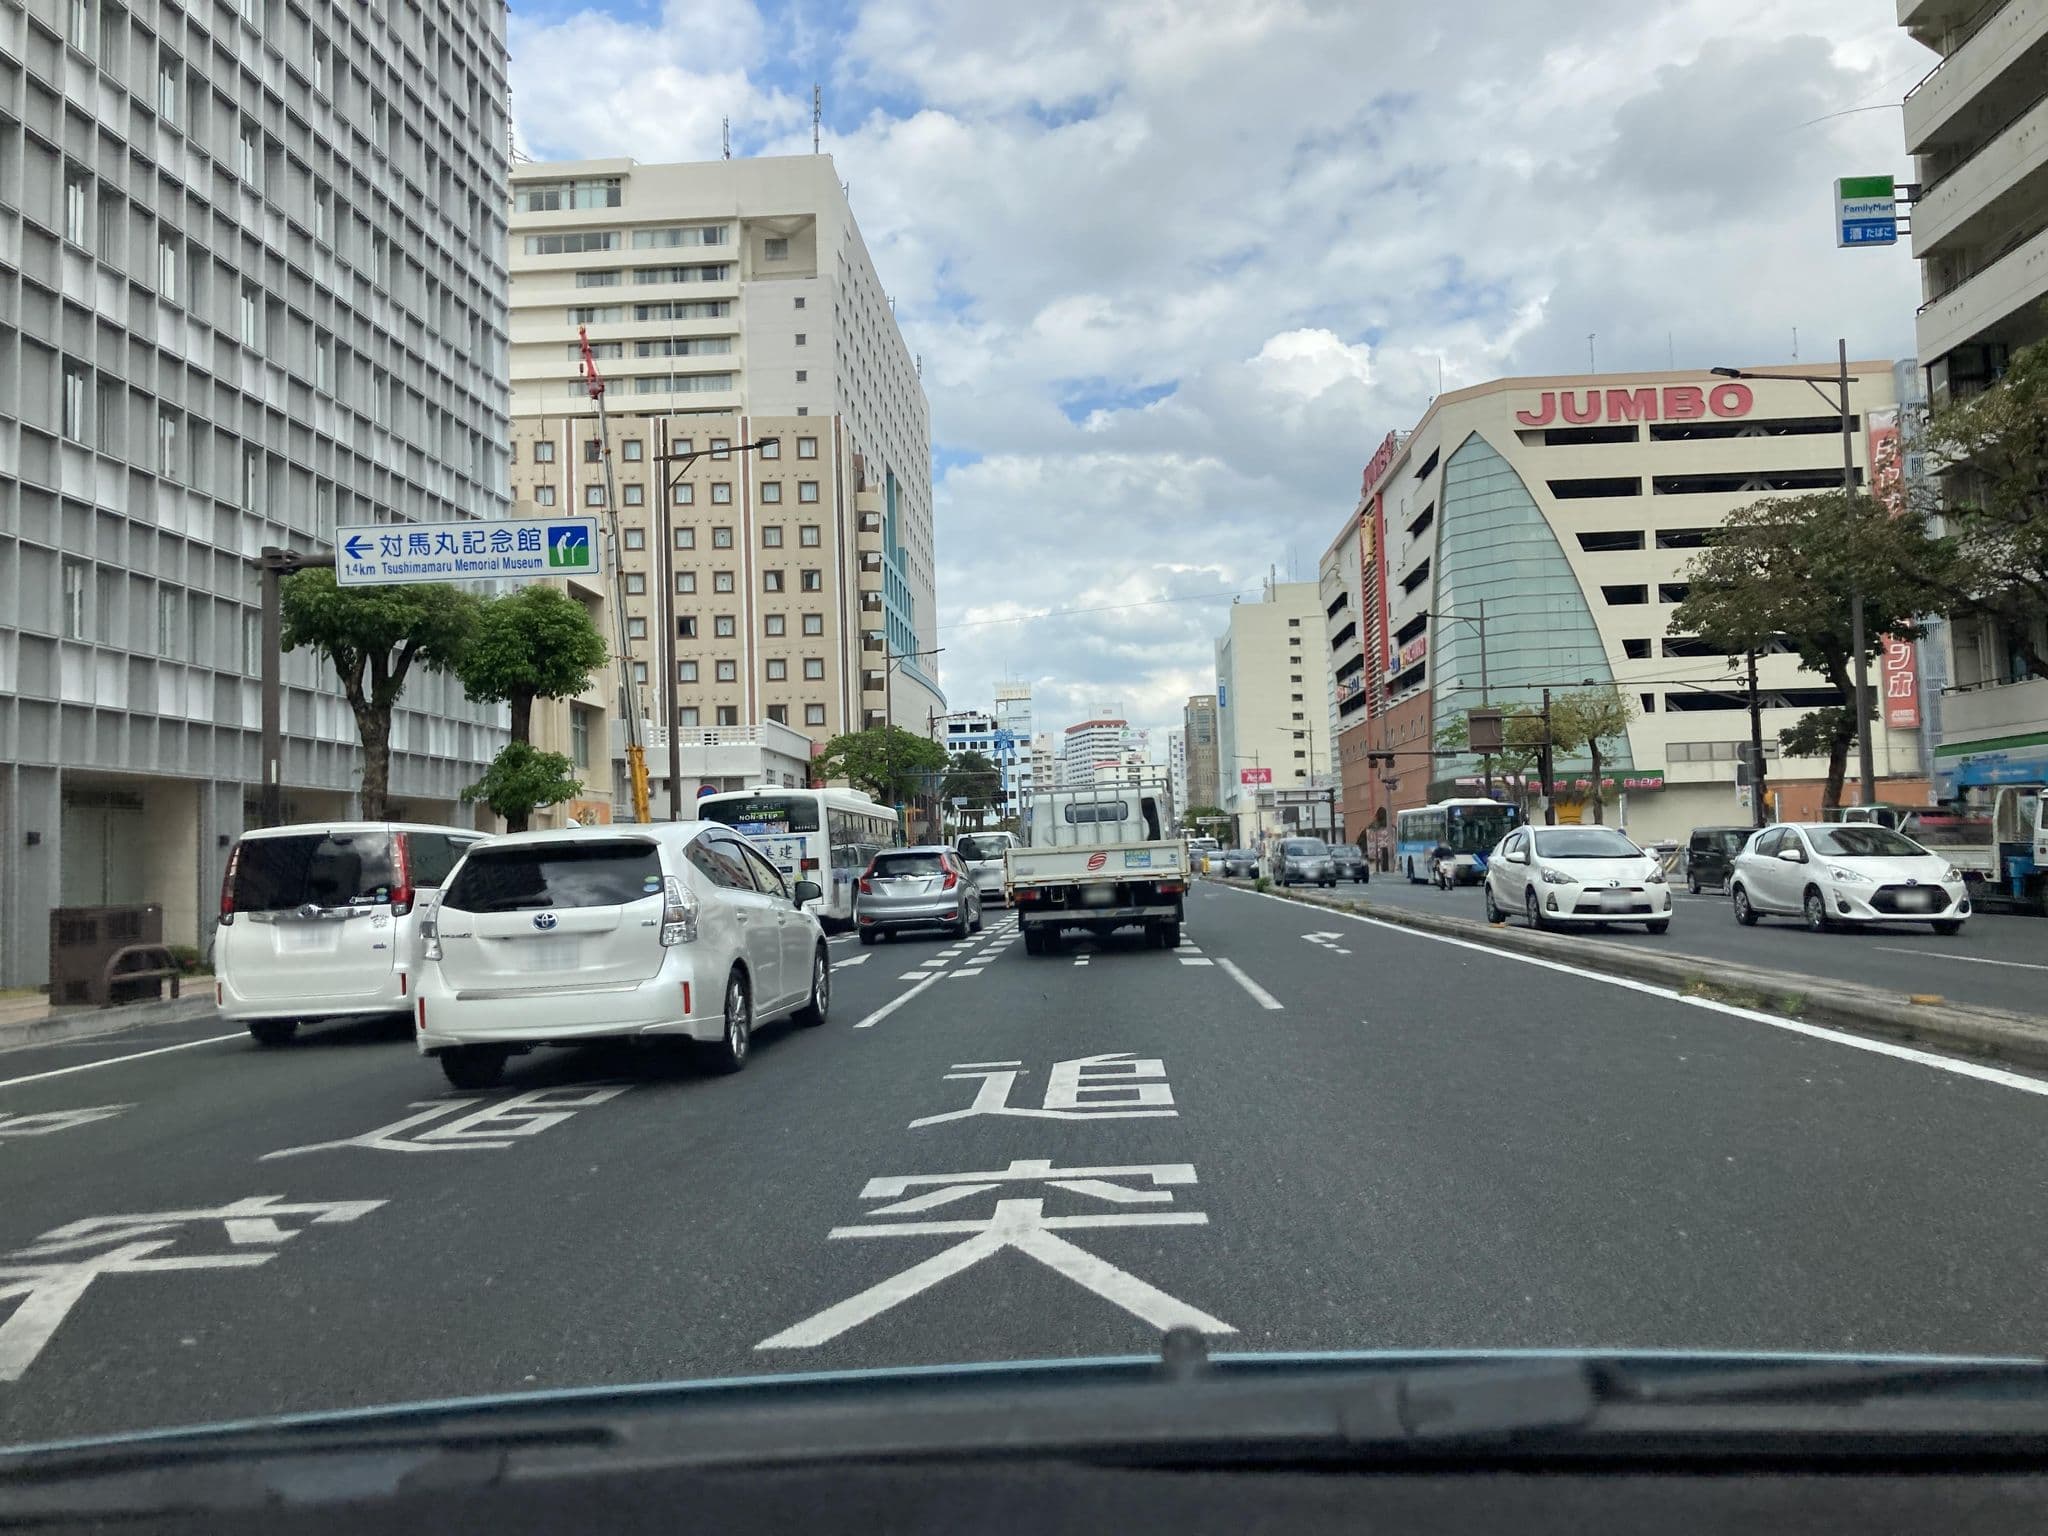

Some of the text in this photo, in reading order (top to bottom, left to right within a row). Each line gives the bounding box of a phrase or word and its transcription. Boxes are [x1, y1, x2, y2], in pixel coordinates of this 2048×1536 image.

[1843, 203, 1893, 213] FamilyMart
[1866, 227, 1892, 239] たばこ
[1516, 383, 1754, 426] JUMBO
[379, 527, 542, 558] 対馬丸記念館
[345, 557, 543, 576] 1.4km Tsushimamaru Memorial Museum
